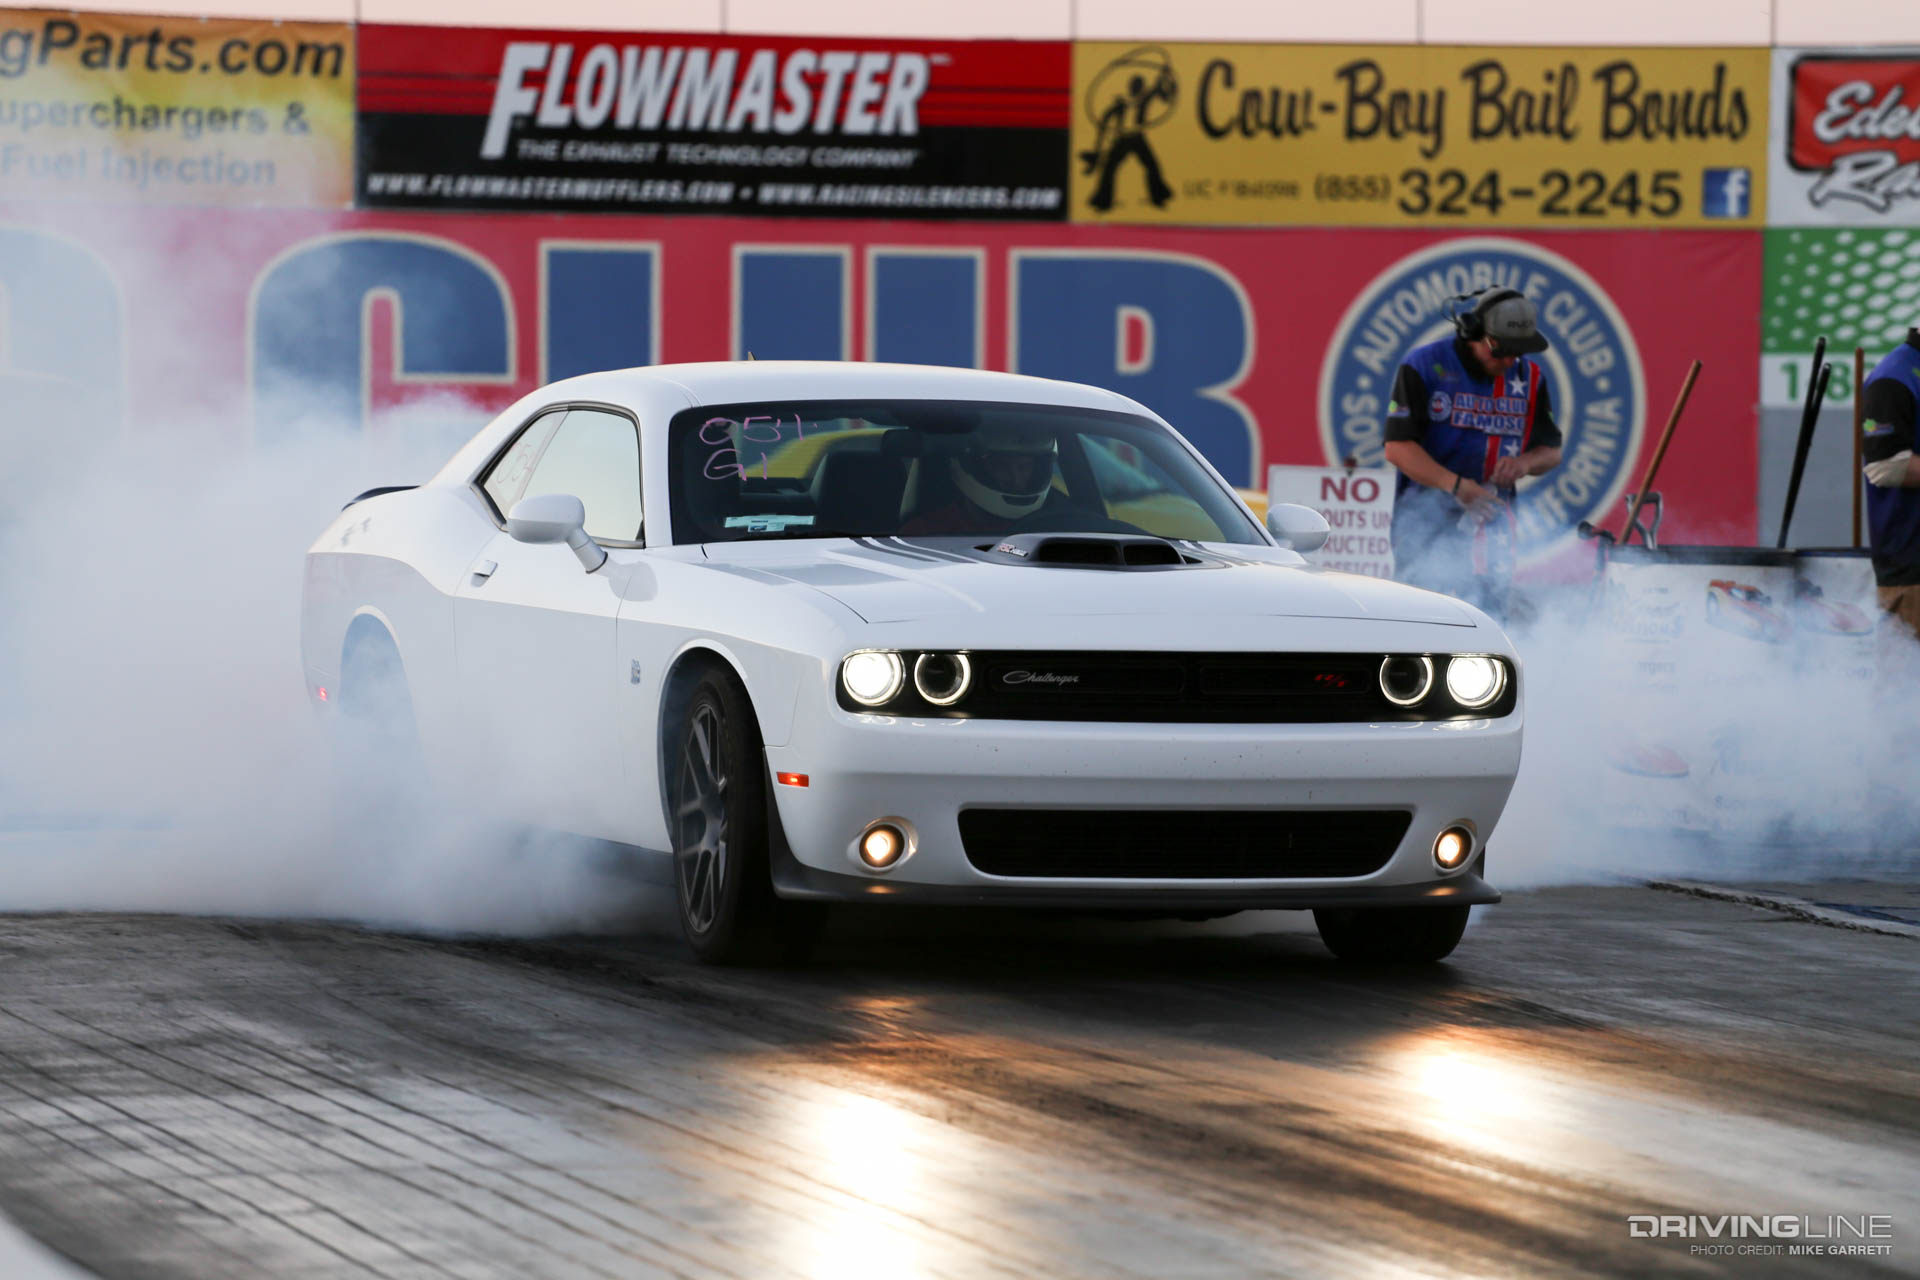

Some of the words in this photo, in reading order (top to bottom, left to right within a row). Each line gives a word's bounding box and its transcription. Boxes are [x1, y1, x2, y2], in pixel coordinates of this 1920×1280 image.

[0, 20, 344, 78] gParts.com
[0, 97, 268, 139] uperchargers
[282, 101, 310, 134] &
[481, 43, 931, 160] FLOWMASTER
[1460, 60, 1578, 143] Bail
[1593, 60, 1750, 143] Bonds
[516, 138, 558, 161] THE
[563, 140, 661, 164] EXHAUST
[667, 142, 809, 168] TECHNOLOGY
[811, 146, 919, 169] COMPANY
[1398, 168, 1682, 217] 324-2245
[1544, 291, 1615, 378] CLUB
[1321, 476, 1380, 503] NO
[1321, 508, 1367, 530] OUTS
[1002, 670, 1081, 686] Challenger
